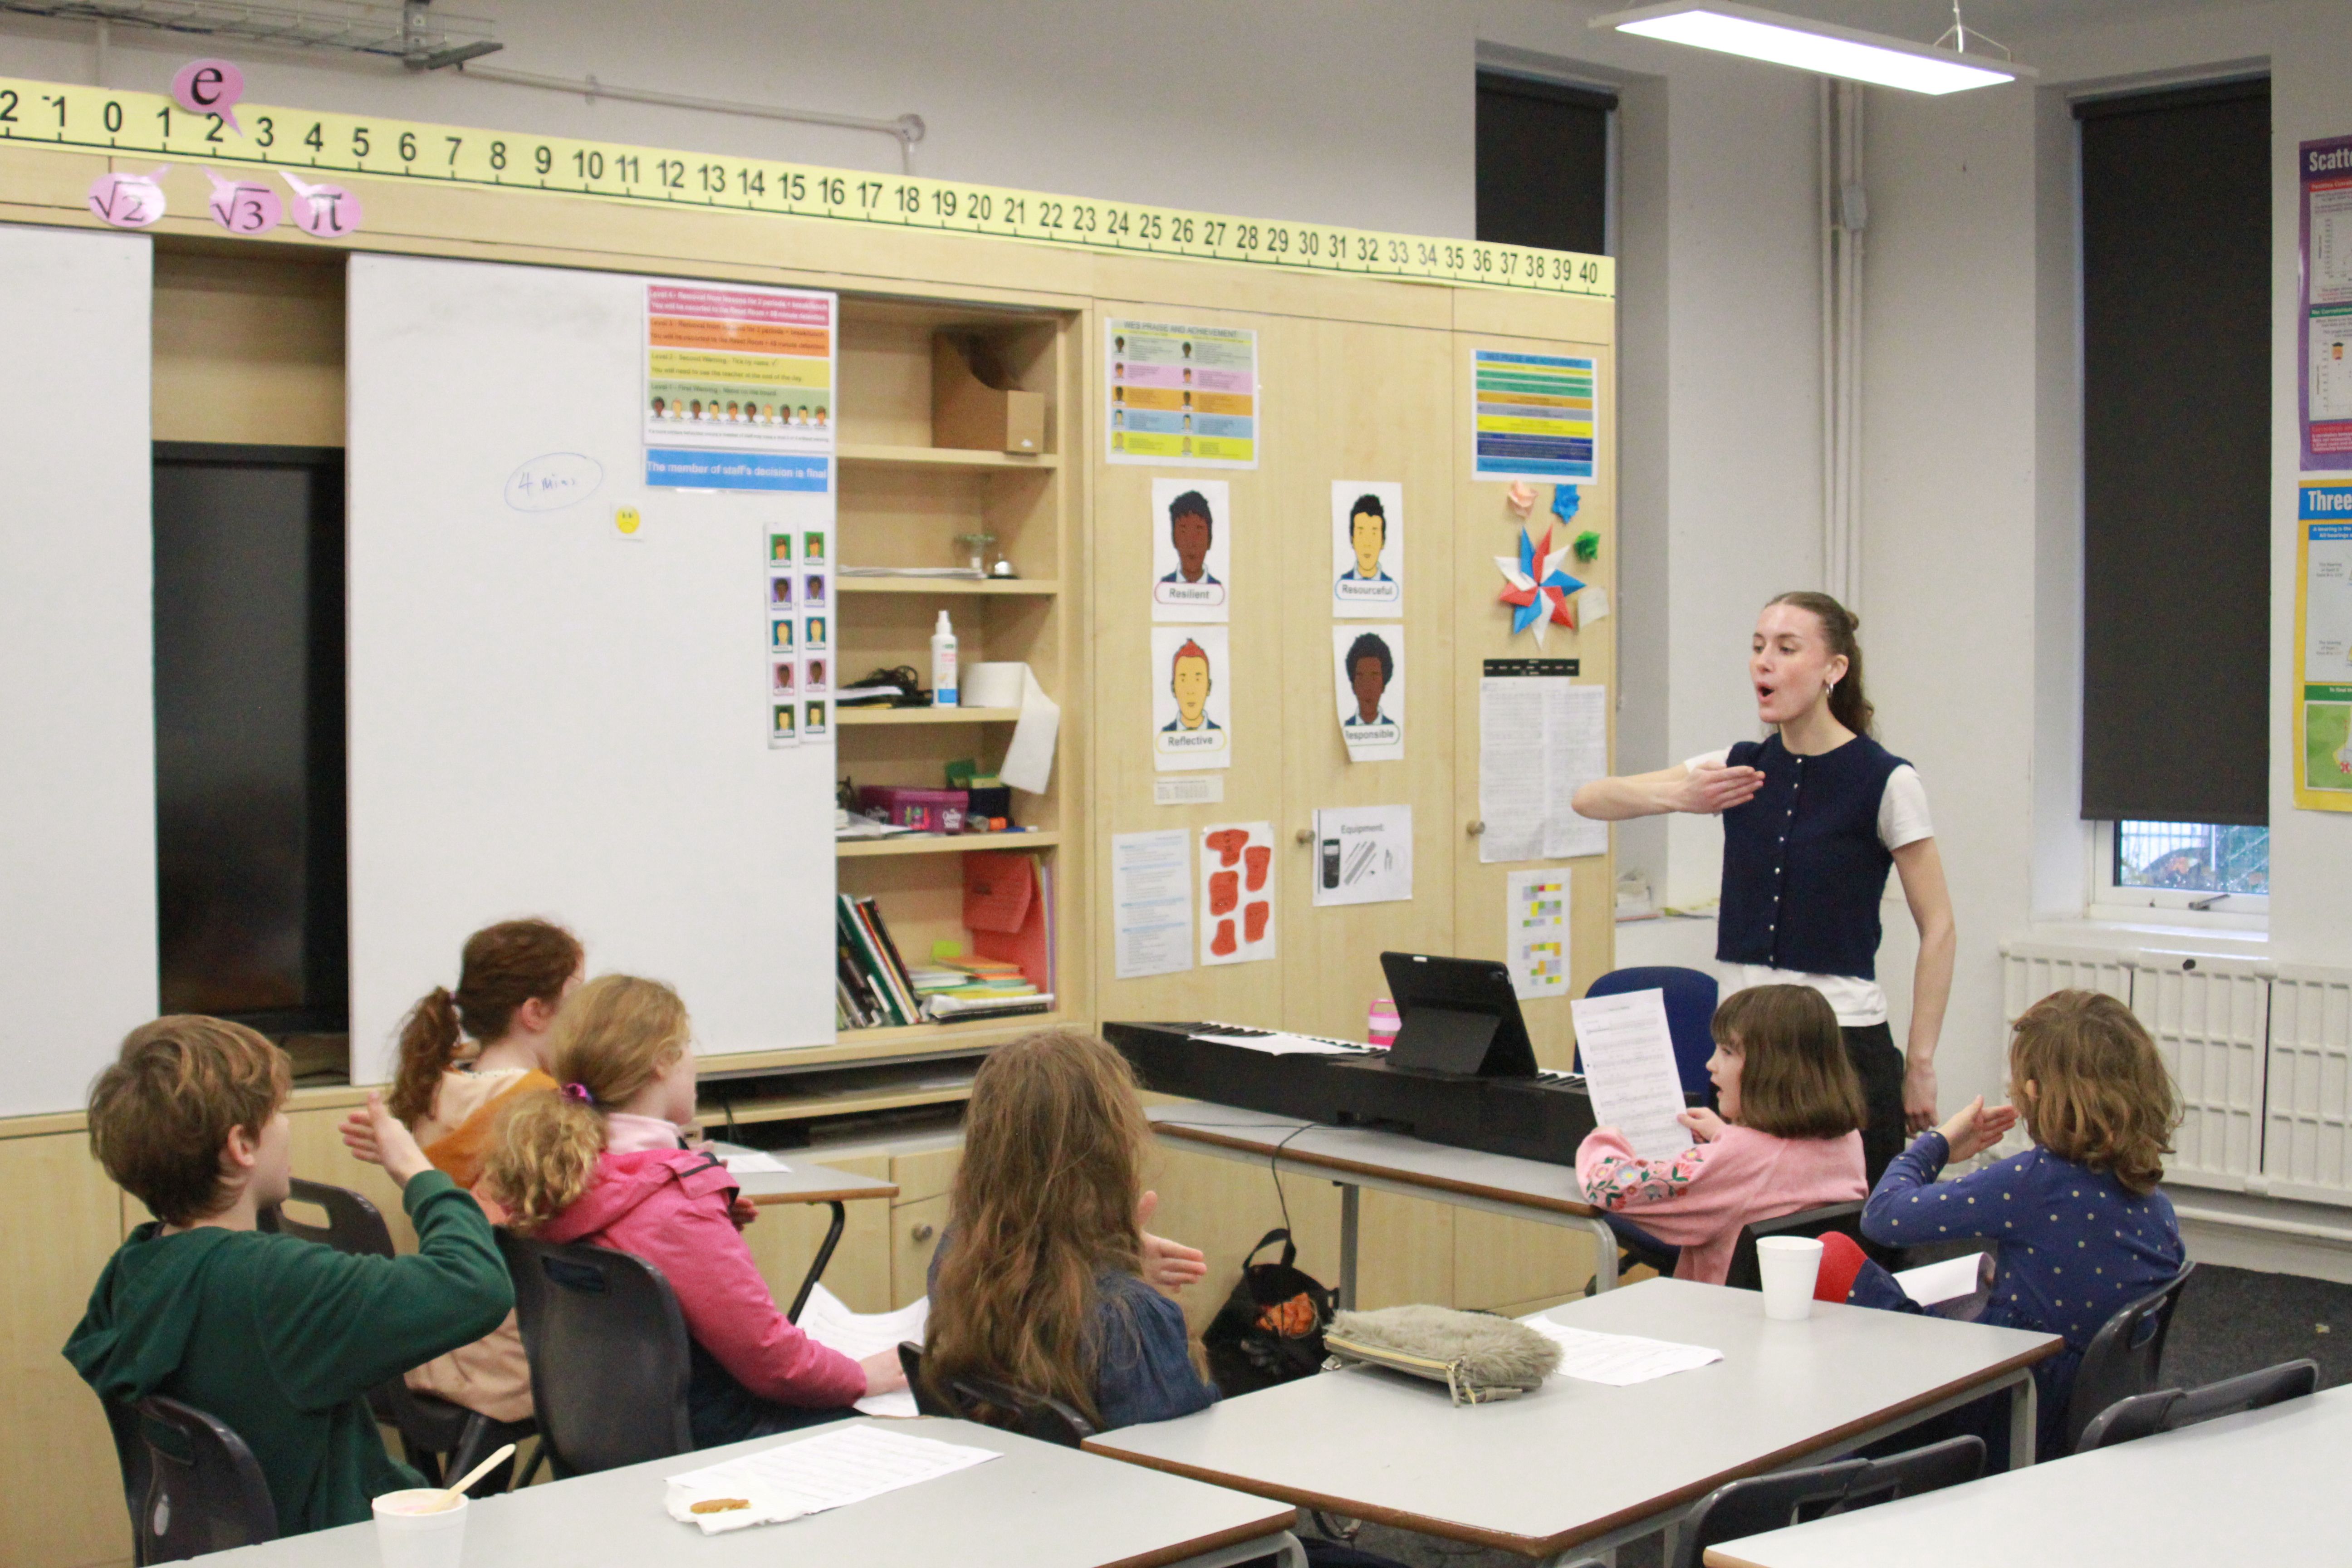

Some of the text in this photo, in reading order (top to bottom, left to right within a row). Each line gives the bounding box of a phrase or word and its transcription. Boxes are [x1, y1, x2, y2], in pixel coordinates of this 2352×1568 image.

[190, 67, 223, 105] e
[104, 101, 122, 132] 0
[157, 107, 170, 137] 1
[205, 113, 224, 142] 2
[256, 117, 274, 147] 3
[304, 122, 323, 152] 4
[352, 127, 370, 157] 5
[398, 132, 416, 162] 6
[446, 137, 462, 165] 7
[489, 141, 506, 170] 8
[534, 145, 551, 174] 9
[572, 149, 603, 179] 10
[614, 154, 639, 183] 11
[656, 159, 684, 188] 12
[697, 163, 726, 192] 13
[737, 168, 765, 197] 14
[777, 172, 805, 201] 15
[818, 176, 845, 205] 16
[856, 180, 883, 208] 17
[894, 184, 920, 213] 18
[931, 188, 956, 216] 19
[967, 193, 991, 220] 20
[1004, 197, 1024, 224] 21
[1039, 201, 1063, 228] 22
[1073, 205, 1096, 232] 23
[1107, 209, 1129, 235] 24
[1139, 212, 1161, 240] 25
[1171, 216, 1194, 243] 26
[1204, 220, 1226, 246] 27
[1236, 224, 1258, 250] 28
[1267, 227, 1289, 253] 29
[1298, 230, 1318, 255] 30
[1328, 234, 1346, 258] 31
[1357, 237, 1378, 261] 32
[1388, 240, 1409, 264] 33
[1417, 243, 1438, 266] 34
[1445, 245, 1464, 269] 35
[1473, 248, 1492, 272] 36
[1500, 252, 1518, 274] 37
[1526, 255, 1544, 278] 38
[1553, 258, 1572, 281] 39
[1579, 260, 1597, 284] 40
[647, 462, 665, 472] The
[668, 463, 708, 474] member
[710, 464, 721, 474] of
[754, 468, 793, 477] decision
[795, 468, 804, 478] is
[806, 468, 827, 478] final
[2308, 490, 2352, 511] Three
[1170, 588, 1210, 599] Resilient
[1342, 584, 1393, 595] Resourceful
[1168, 735, 1213, 746] Reflective
